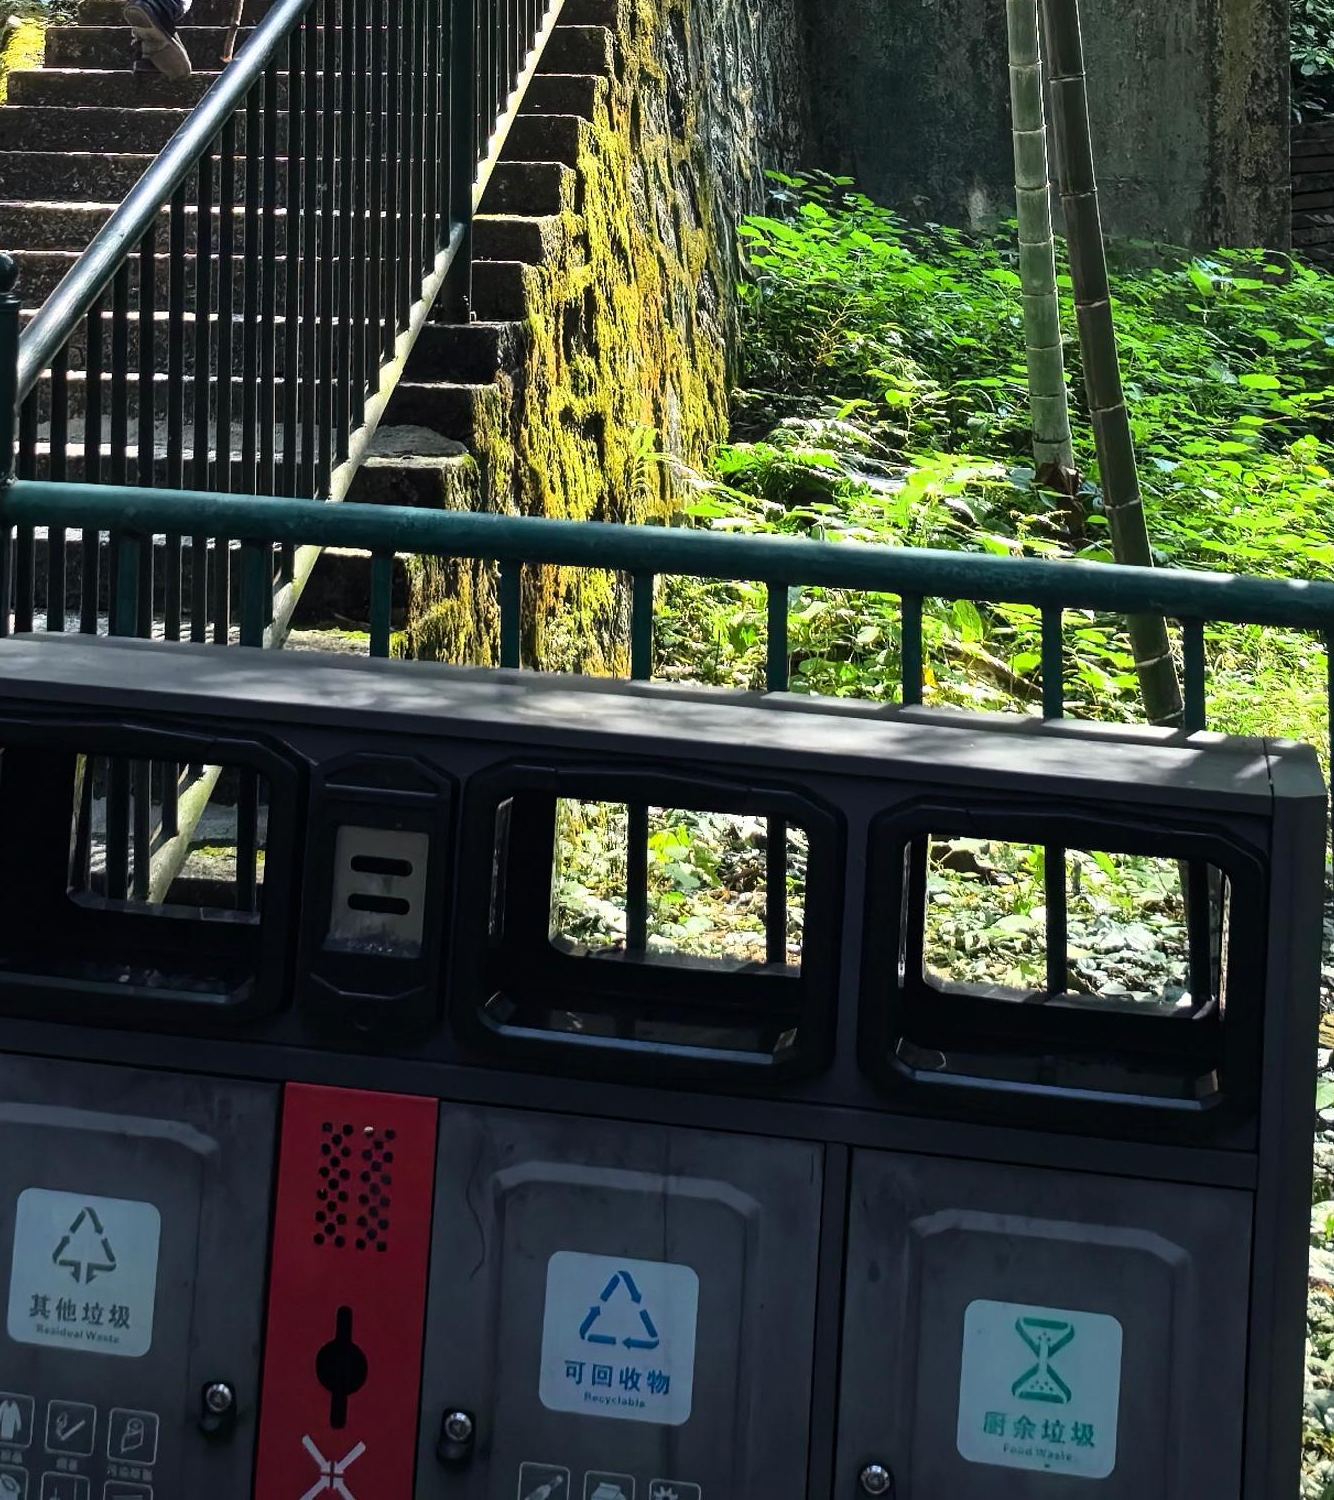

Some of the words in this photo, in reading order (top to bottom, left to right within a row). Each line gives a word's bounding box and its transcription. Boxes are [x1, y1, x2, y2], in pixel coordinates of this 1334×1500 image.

[29, 1293, 131, 1330] 其他垃圾
[36, 1323, 83, 1339] Residual
[86, 1330, 120, 1344] Waste
[564, 1360, 670, 1396] 可回收物
[584, 1391, 646, 1409] Recyclable
[983, 1411, 1095, 1449] 厨余垃圾
[1003, 1443, 1033, 1456] Food
[1035, 1447, 1073, 1461] Waste
